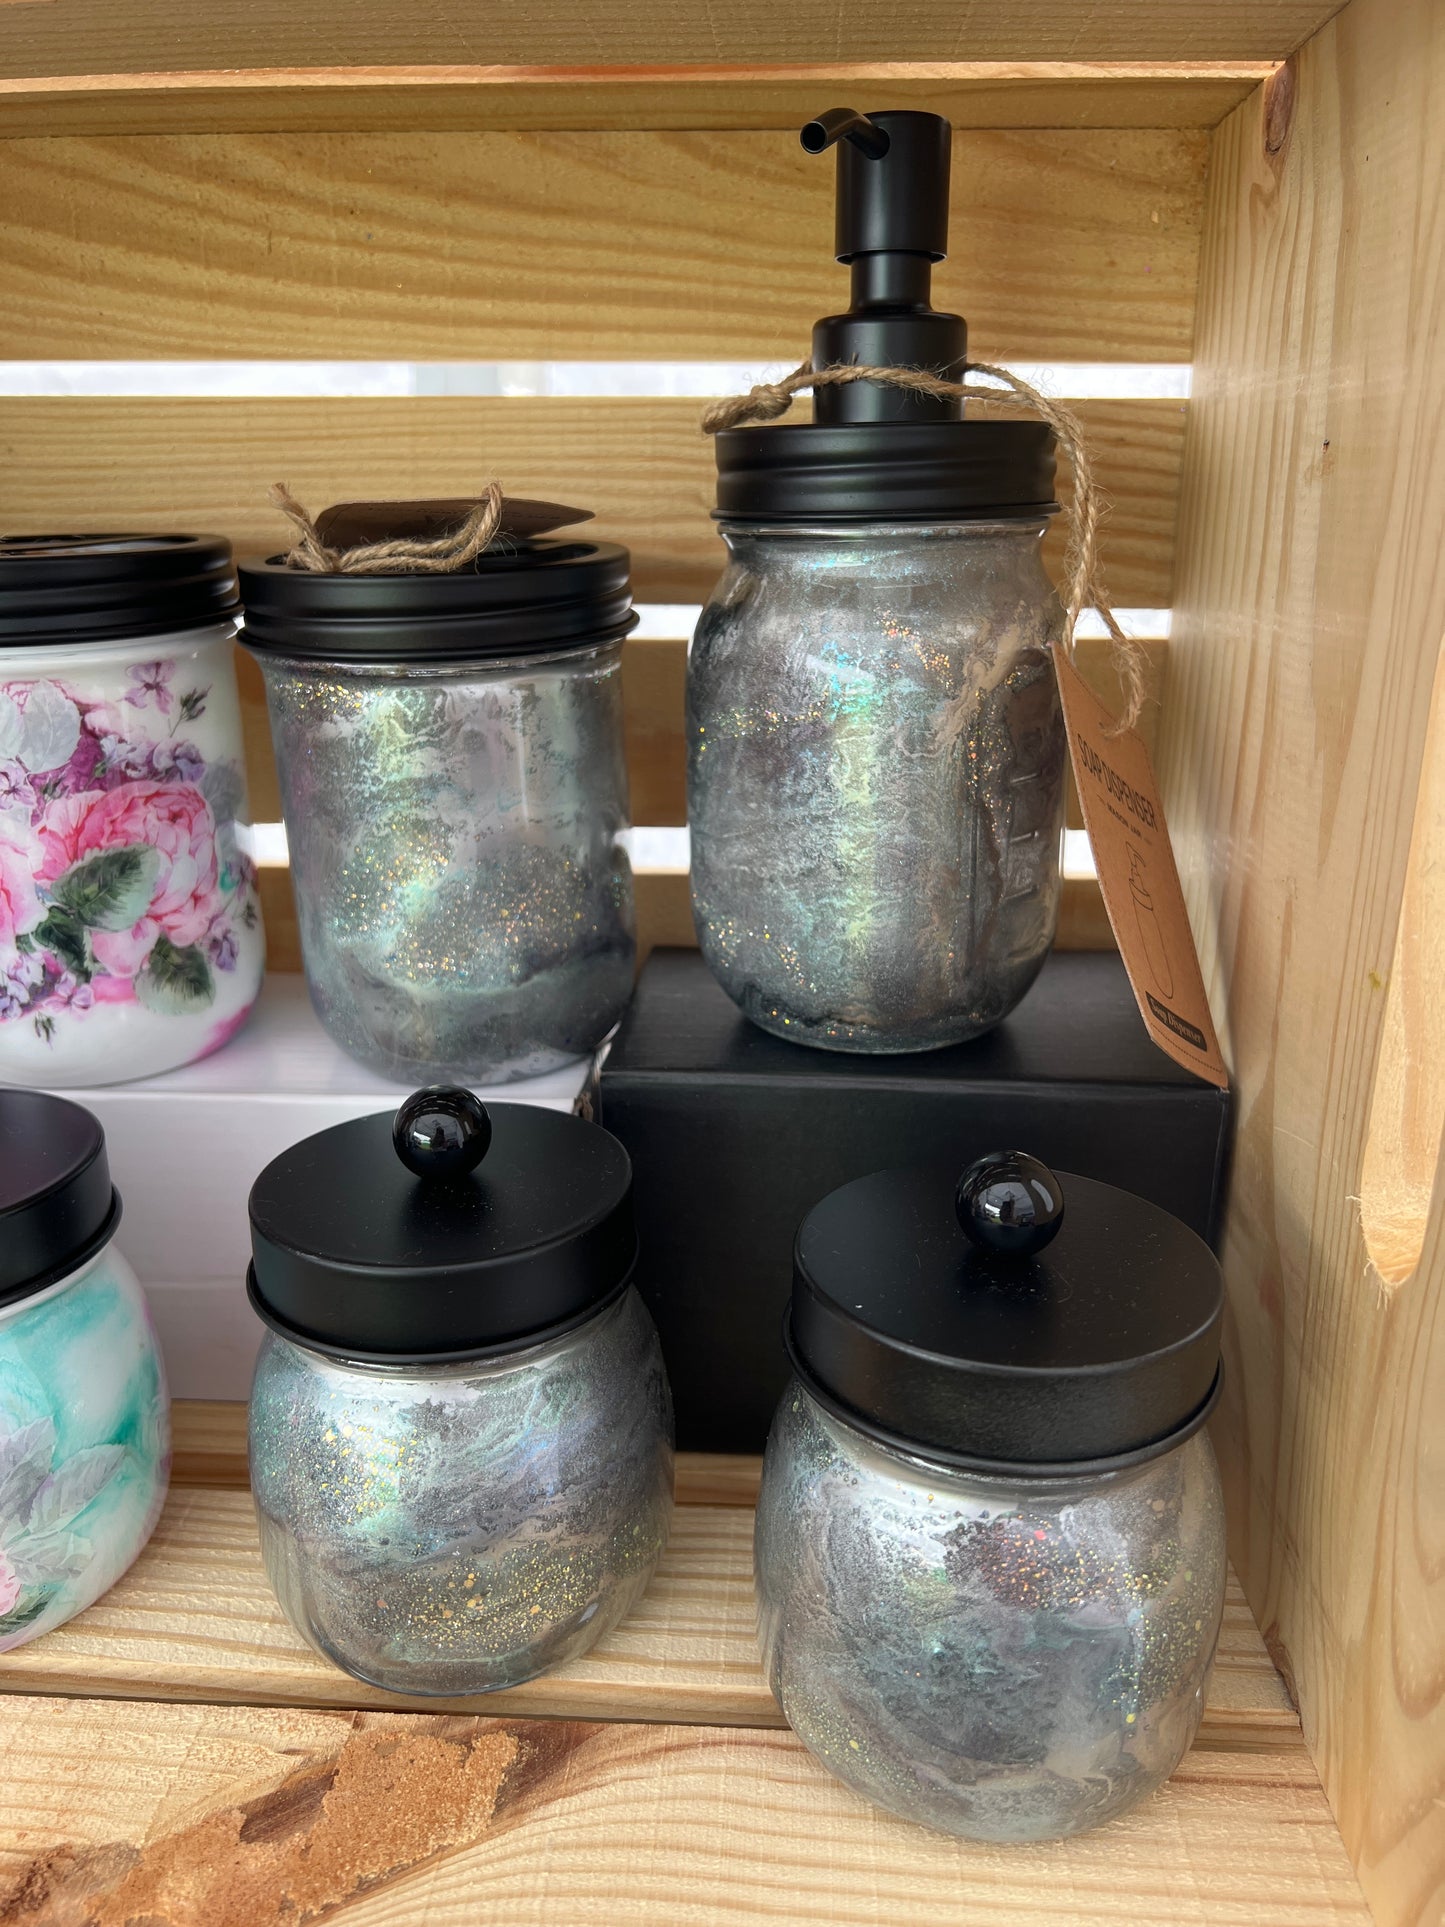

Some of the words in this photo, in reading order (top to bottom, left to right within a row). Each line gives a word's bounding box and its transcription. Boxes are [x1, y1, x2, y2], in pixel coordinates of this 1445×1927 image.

[1077, 732, 1102, 784] SOAP
[1102, 760, 1158, 832] DISPENSER
[1168, 1011, 1201, 1044] Dispenser
